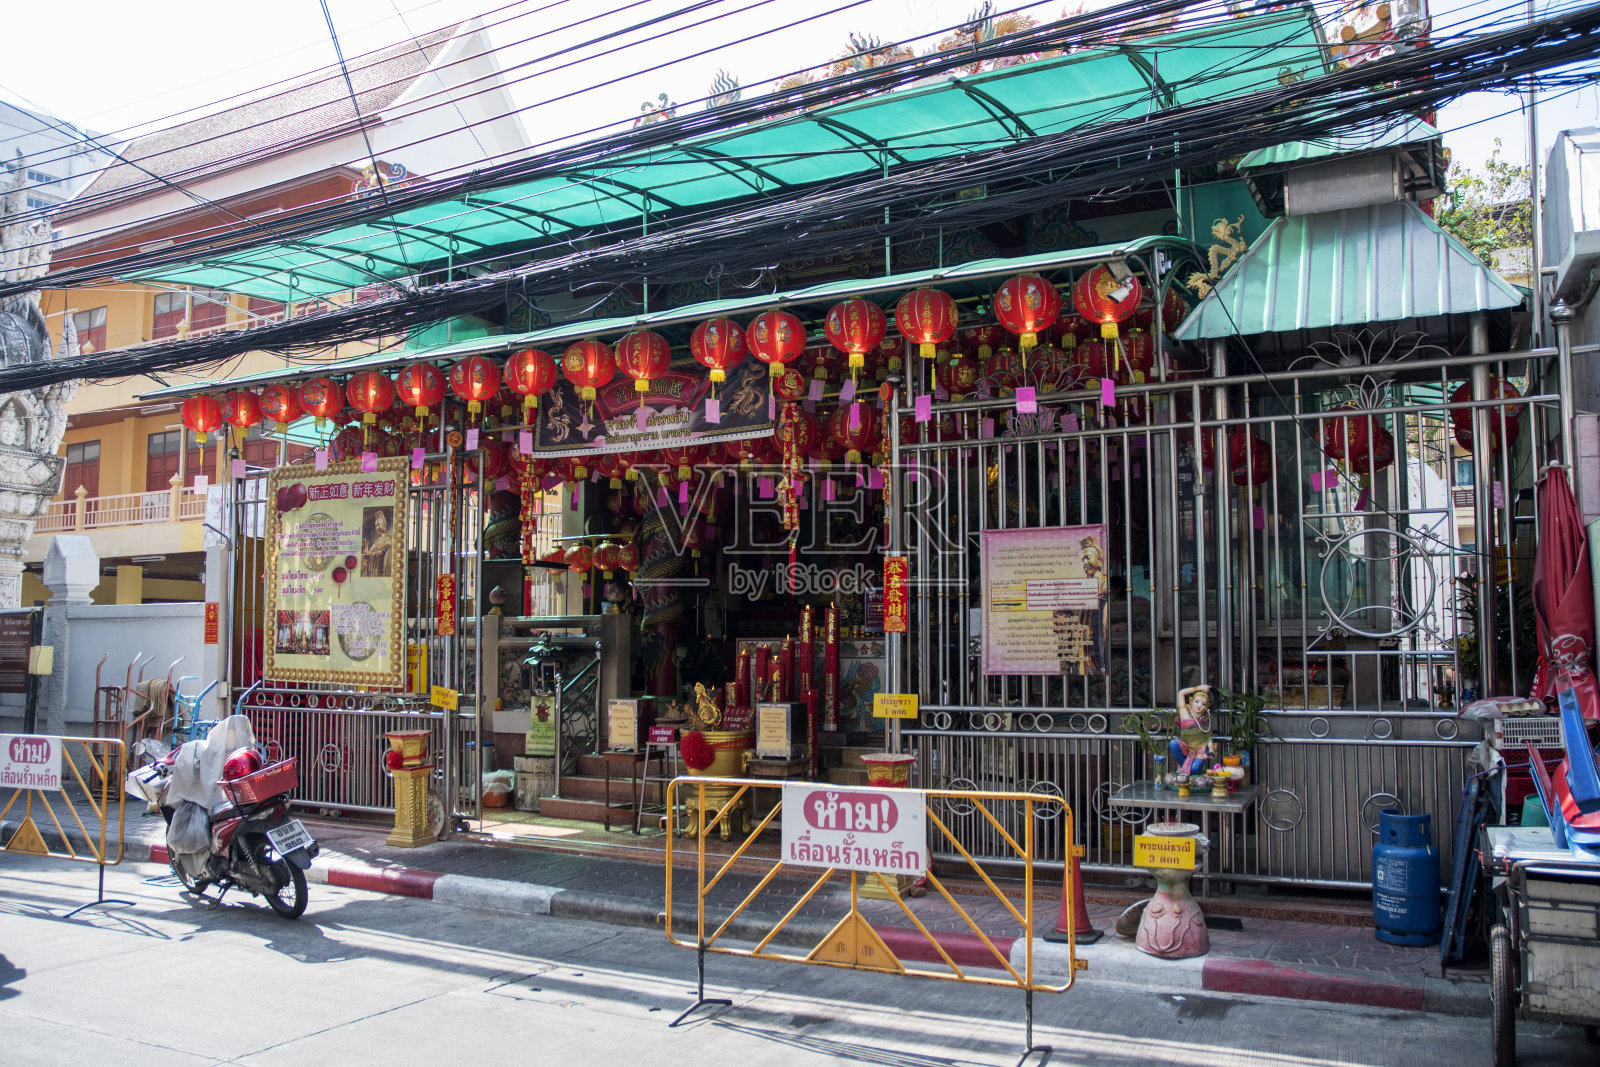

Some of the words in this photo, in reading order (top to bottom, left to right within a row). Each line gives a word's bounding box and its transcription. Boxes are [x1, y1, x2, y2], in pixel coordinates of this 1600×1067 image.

[606, 409, 690, 431] ศาลเจ้ม่กวนอิม
[308, 483, 349, 501] 新正如意
[352, 480, 396, 498] 新年发财
[886, 560, 904, 617] 恭喜發財
[13, 738, 48, 763] ห้าม!
[0, 762, 58, 788] เลื่อนรั้วเหล็ก
[814, 791, 890, 832] ห้าม!
[790, 829, 920, 871] เลื่อนรั้วเหล็ก
[1139, 841, 1191, 853] พระแม่ธรณี
[1149, 854, 1155, 863] 3
[1159, 856, 1180, 865] ดอก
